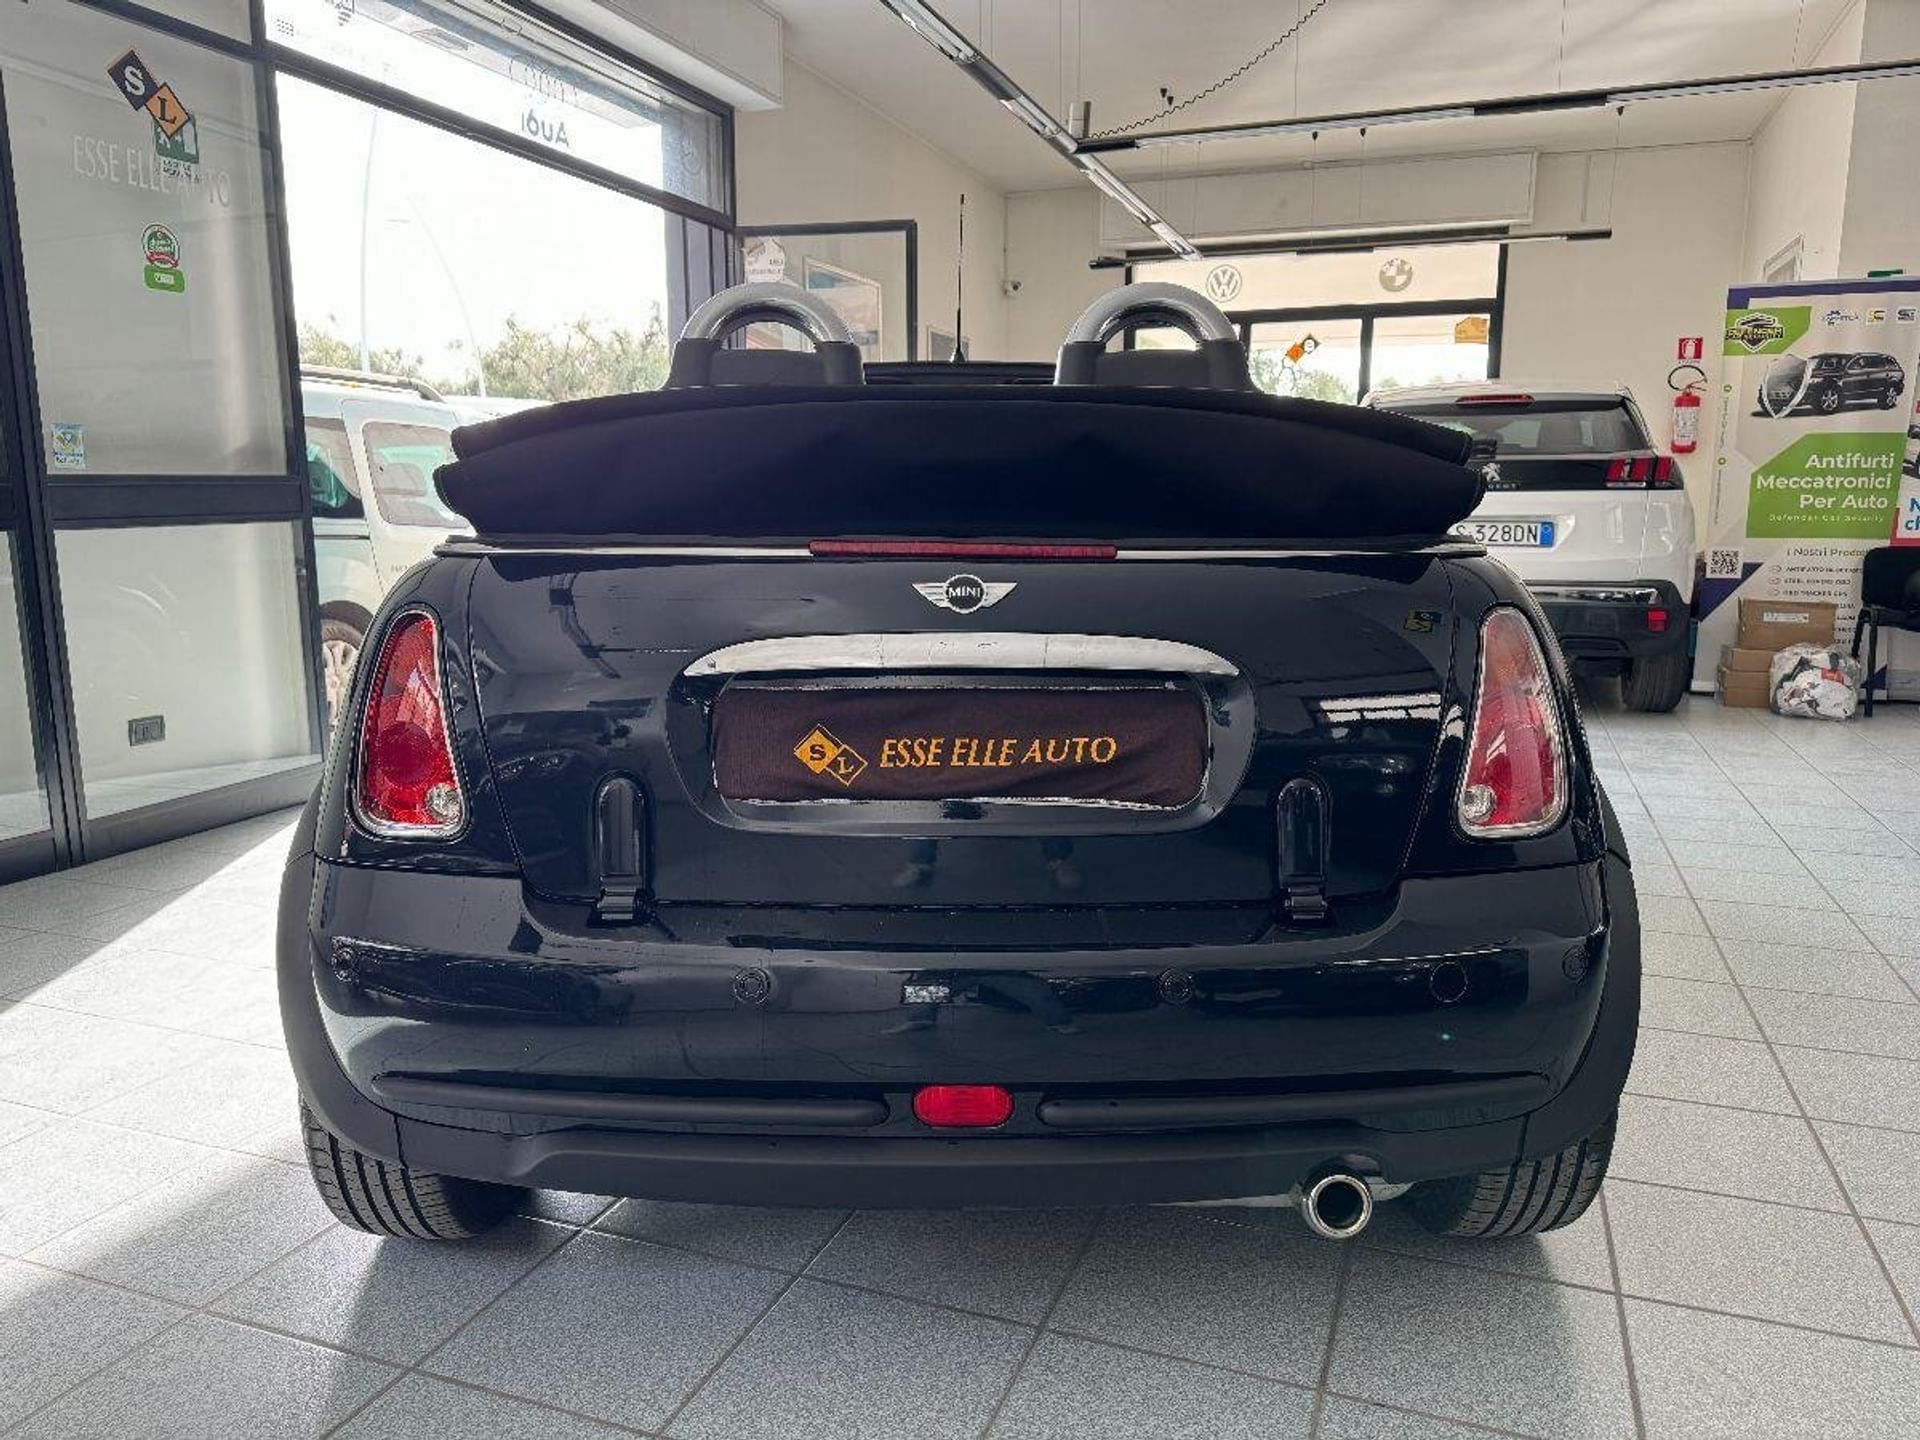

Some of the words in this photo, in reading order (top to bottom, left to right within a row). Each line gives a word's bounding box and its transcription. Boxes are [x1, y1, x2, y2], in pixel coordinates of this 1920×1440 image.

[124, 65, 146, 96] S
[157, 95, 177, 124] L
[73, 133, 121, 183] ESSE
[1804, 452, 1895, 469] Antifurti
[1756, 473, 1892, 489] Meccatronici
[1799, 495, 1837, 509] Per
[1841, 494, 1888, 509] Auto
[1475, 524, 1538, 543] 328DN
[948, 585, 981, 598] MINI
[879, 738, 945, 768] ESSE
[949, 738, 1018, 767] ELLE
[1020, 736, 1118, 764] AUTO
